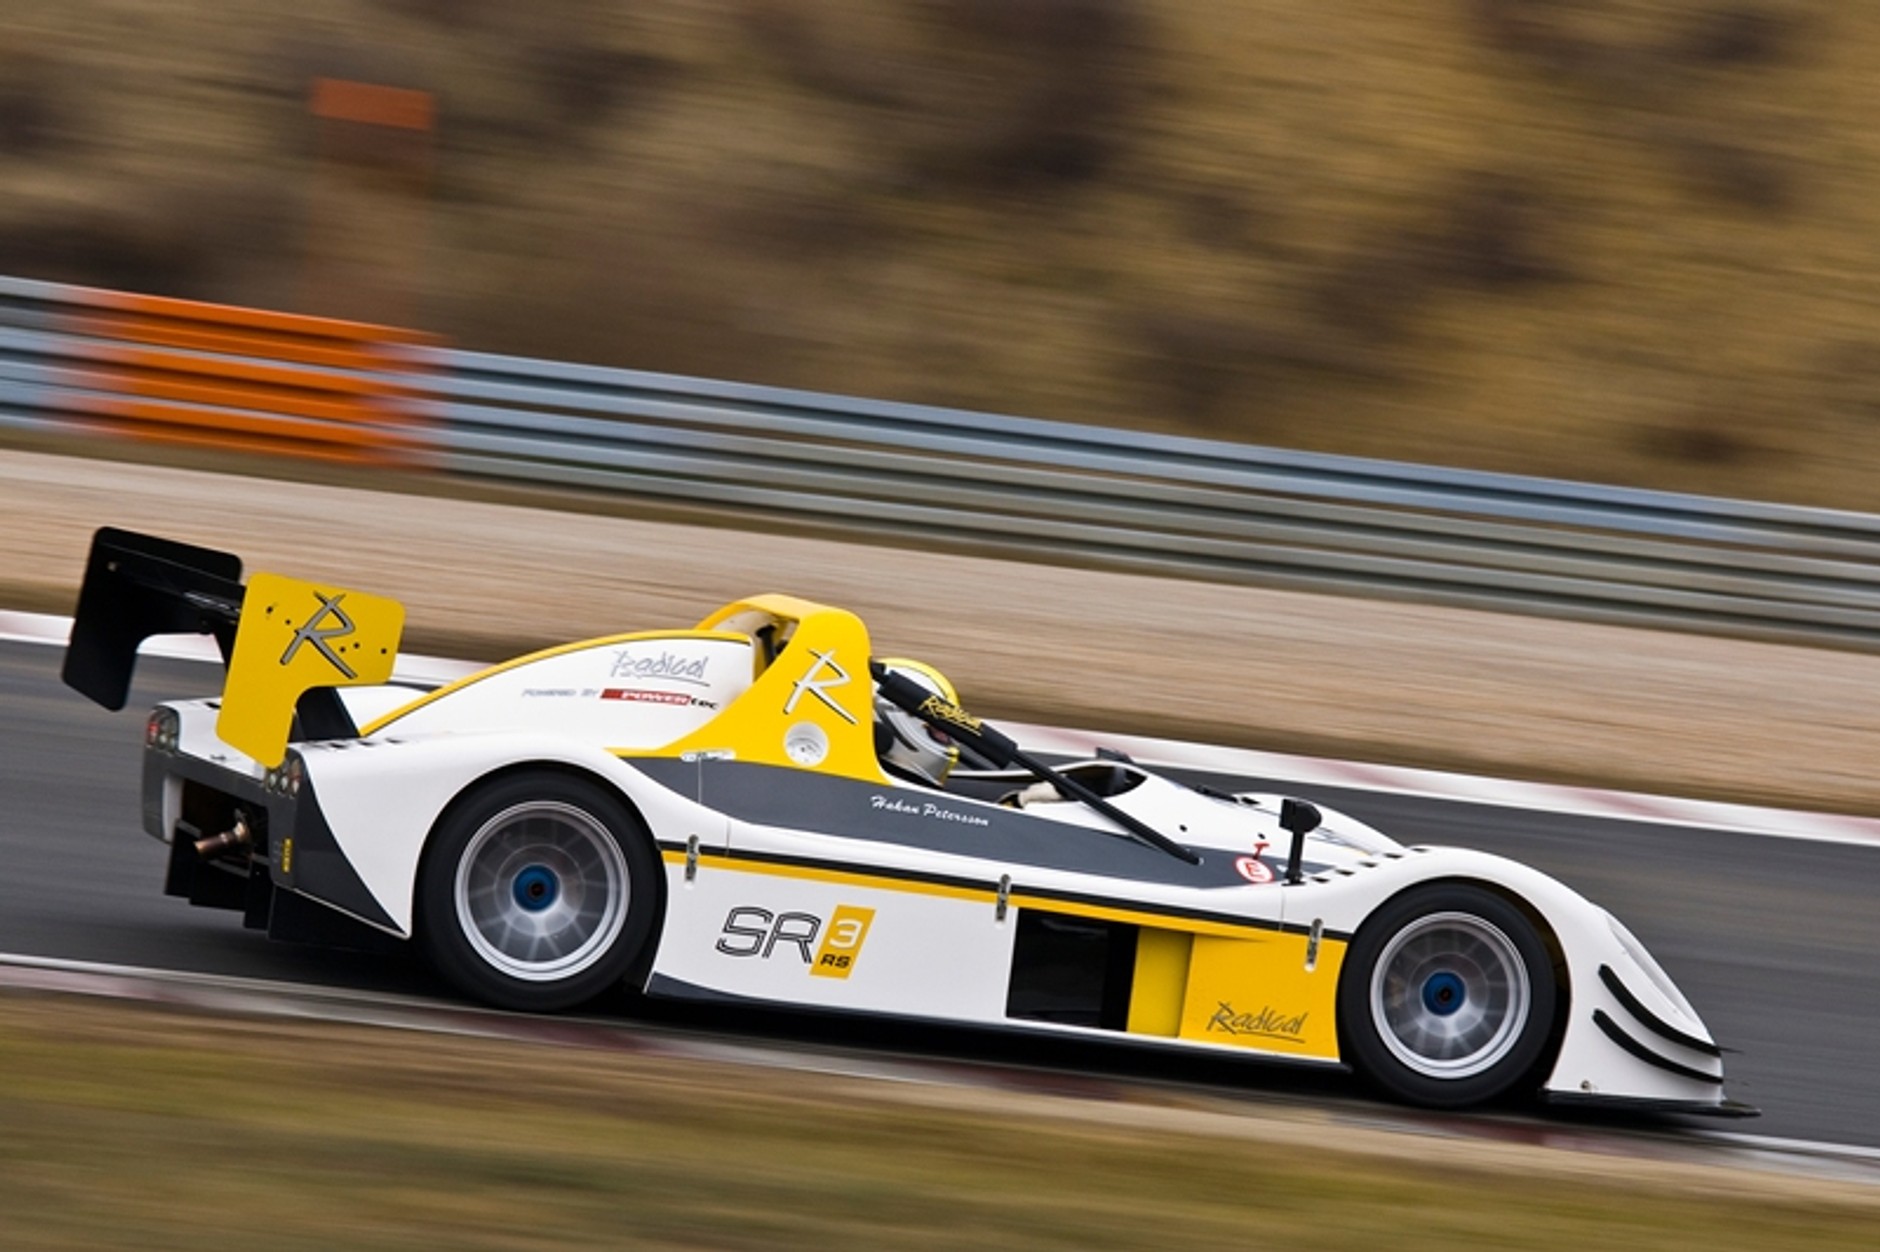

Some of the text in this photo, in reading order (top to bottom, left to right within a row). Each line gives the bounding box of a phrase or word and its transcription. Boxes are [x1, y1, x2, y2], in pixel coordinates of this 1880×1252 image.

[610, 650, 710, 687] Radical
[870, 795, 989, 827] Hakan Petersson
[820, 953, 851, 969] RS
[1206, 1001, 1309, 1043] Radical
